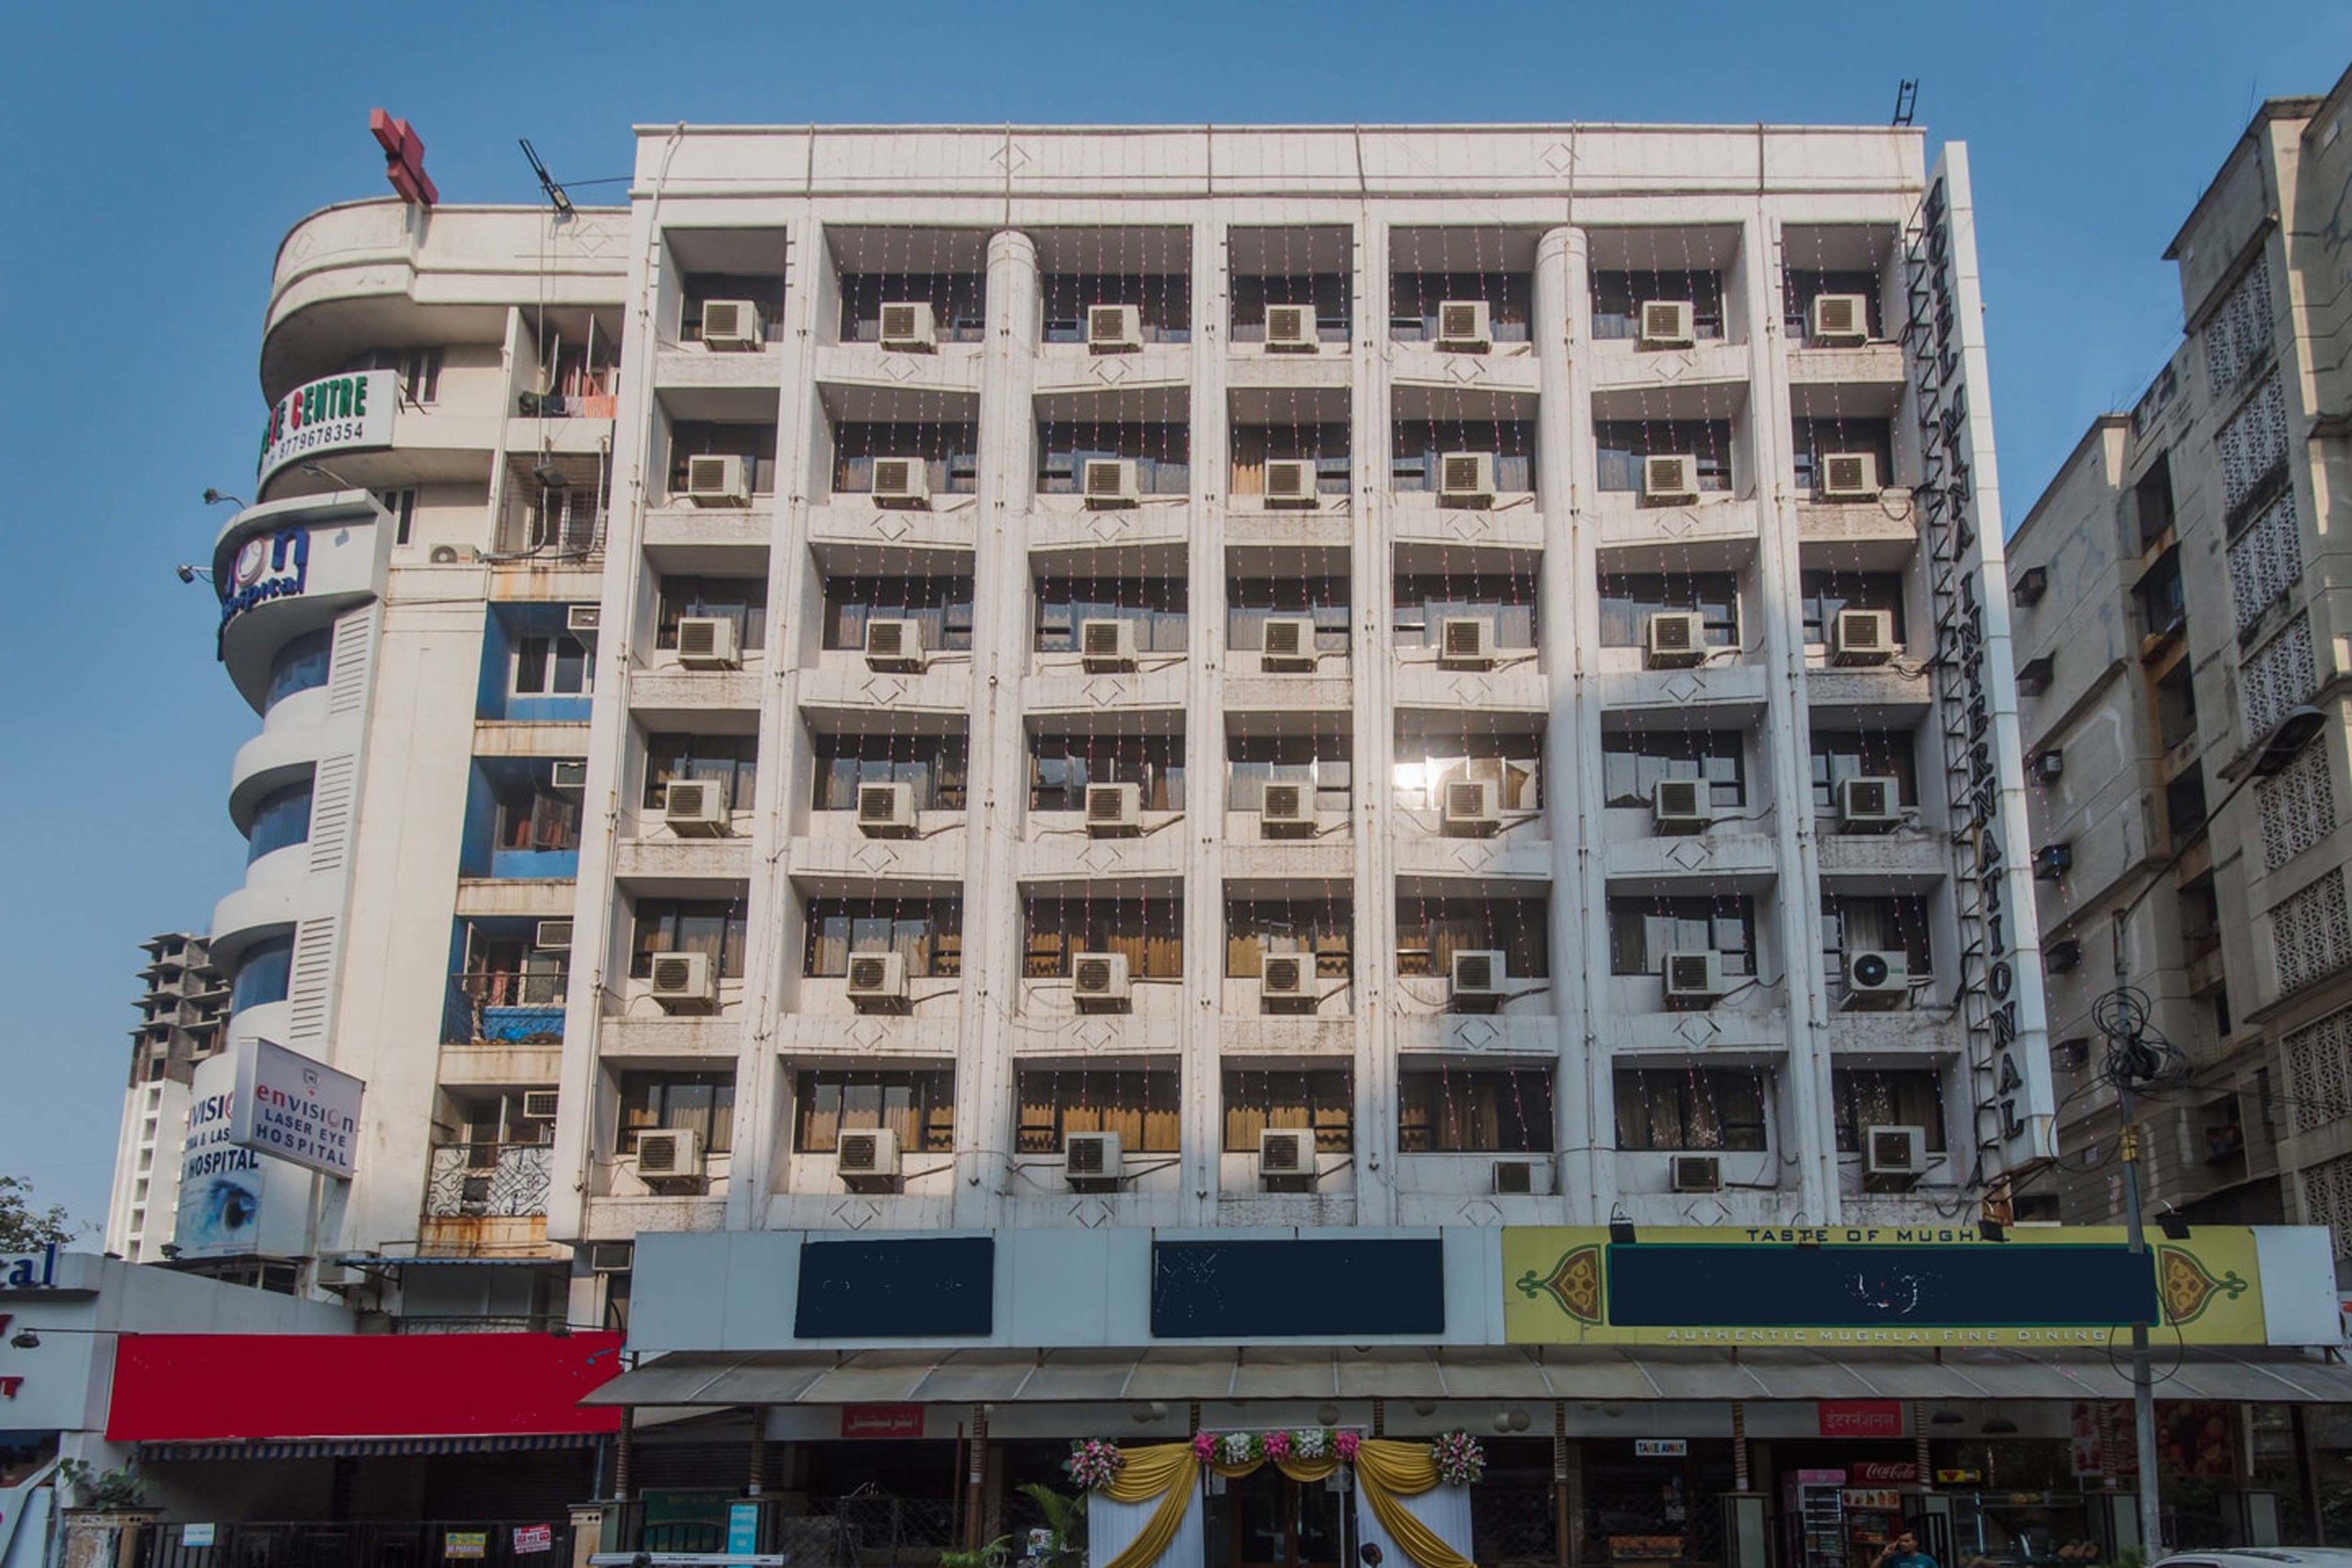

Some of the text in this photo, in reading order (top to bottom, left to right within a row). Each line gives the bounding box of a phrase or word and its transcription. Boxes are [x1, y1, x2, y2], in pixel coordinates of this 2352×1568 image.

[290, 375, 368, 430] CENTRE
[1923, 176, 2025, 1140] HOTEL MINA INTERNATIONAL
[211, 1128, 230, 1144] LAS
[256, 1123, 347, 1166] HOSPITAL
[265, 1109, 346, 1147] LASER EYE
[188, 1149, 258, 1178] HOSPITAL
[1746, 1229, 2011, 1242] TASTE OF MUGH
[1668, 1330, 2105, 1341] AUTHENTIC MUGHLAI FINE DINING
